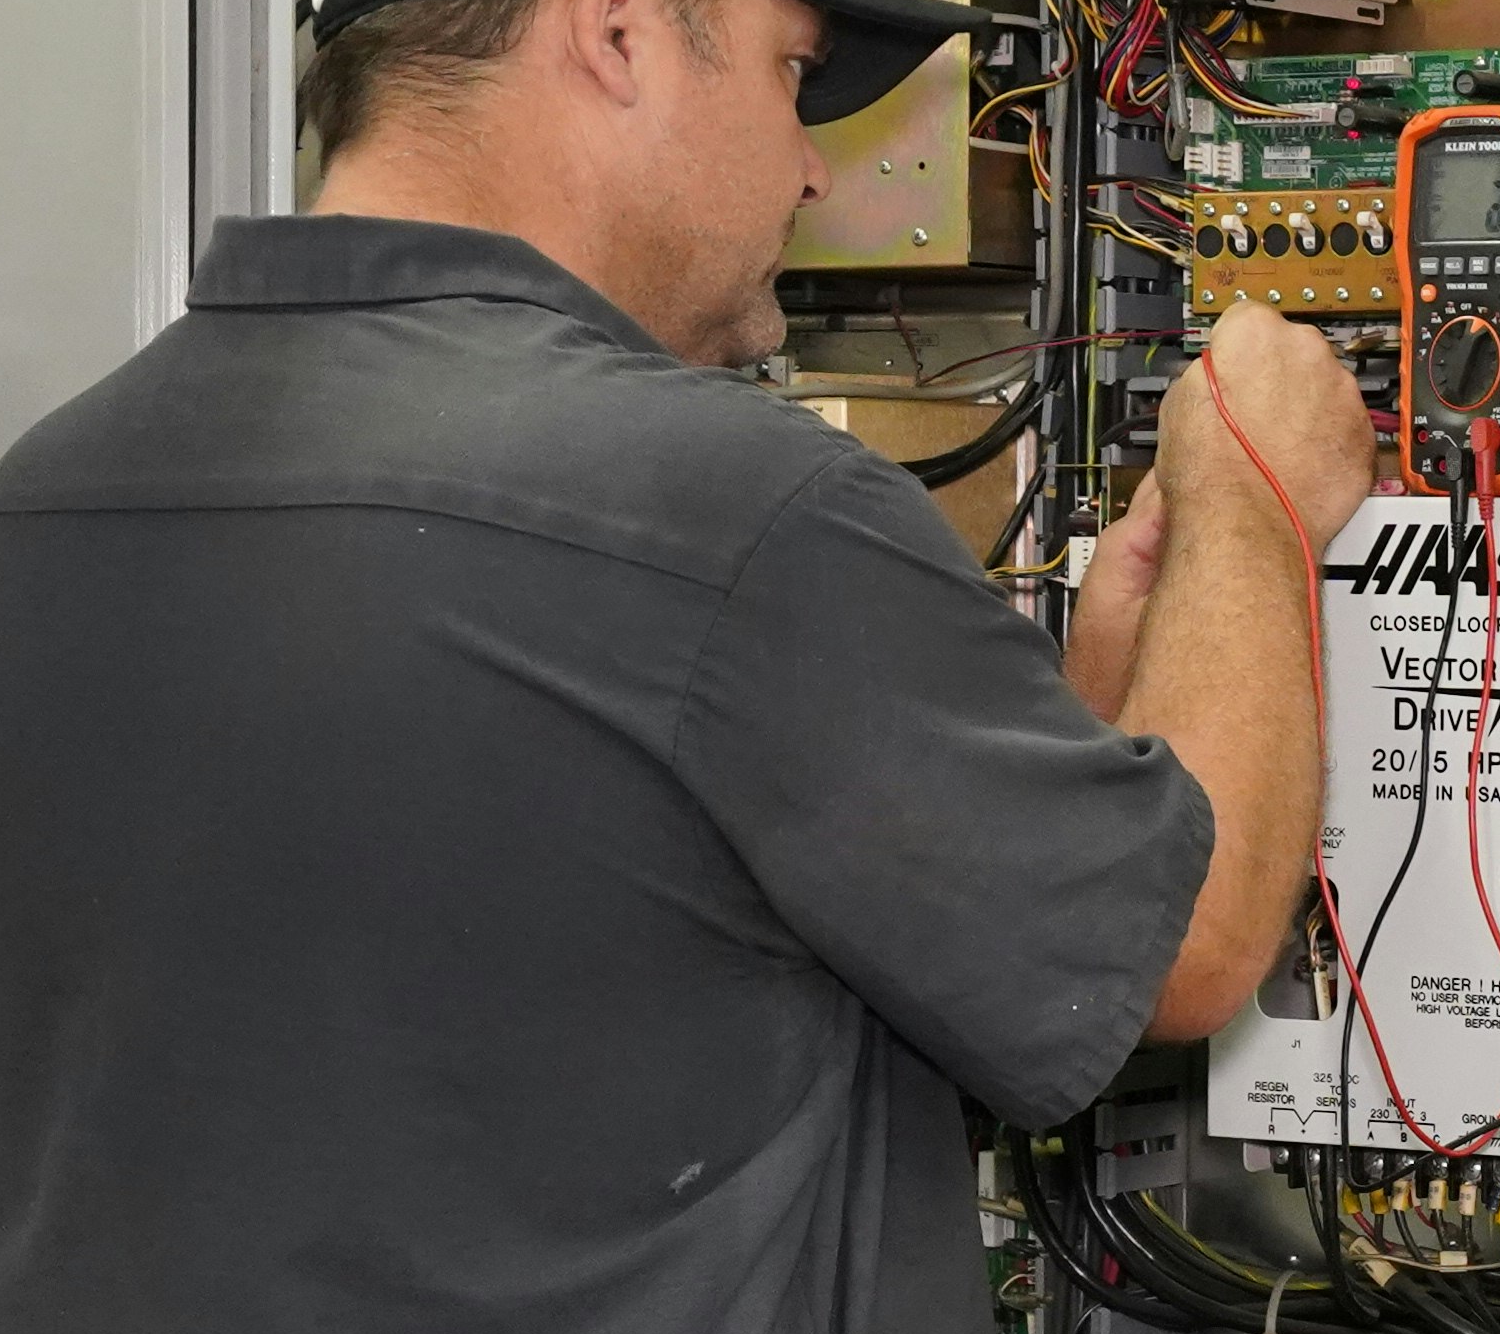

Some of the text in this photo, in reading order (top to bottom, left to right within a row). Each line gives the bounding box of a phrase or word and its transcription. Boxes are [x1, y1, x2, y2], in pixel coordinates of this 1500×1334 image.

[1445, 141, 1477, 152] KLEIN
[1414, 416, 1428, 425] 10A
[1370, 615, 1445, 632] CLOSED
[1372, 749, 1448, 773] 20/5
[1372, 784, 1423, 800] MADE
[1436, 785, 1453, 801] IN
[1411, 975, 1471, 992] DANGER
[1411, 992, 1426, 1002] NO
[1431, 992, 1459, 1004] USER
[1416, 1004, 1441, 1015] HIGH
[1446, 1005, 1492, 1017] VOLTAGE
[1313, 1073, 1333, 1083] 325
[1255, 1081, 1289, 1092] REGEN
[1247, 1093, 1296, 1104] RESISTOR
[1316, 1098, 1357, 1109] SERVS
[1386, 1098, 1416, 1109] INUT
[1370, 1108, 1390, 1119] 230
